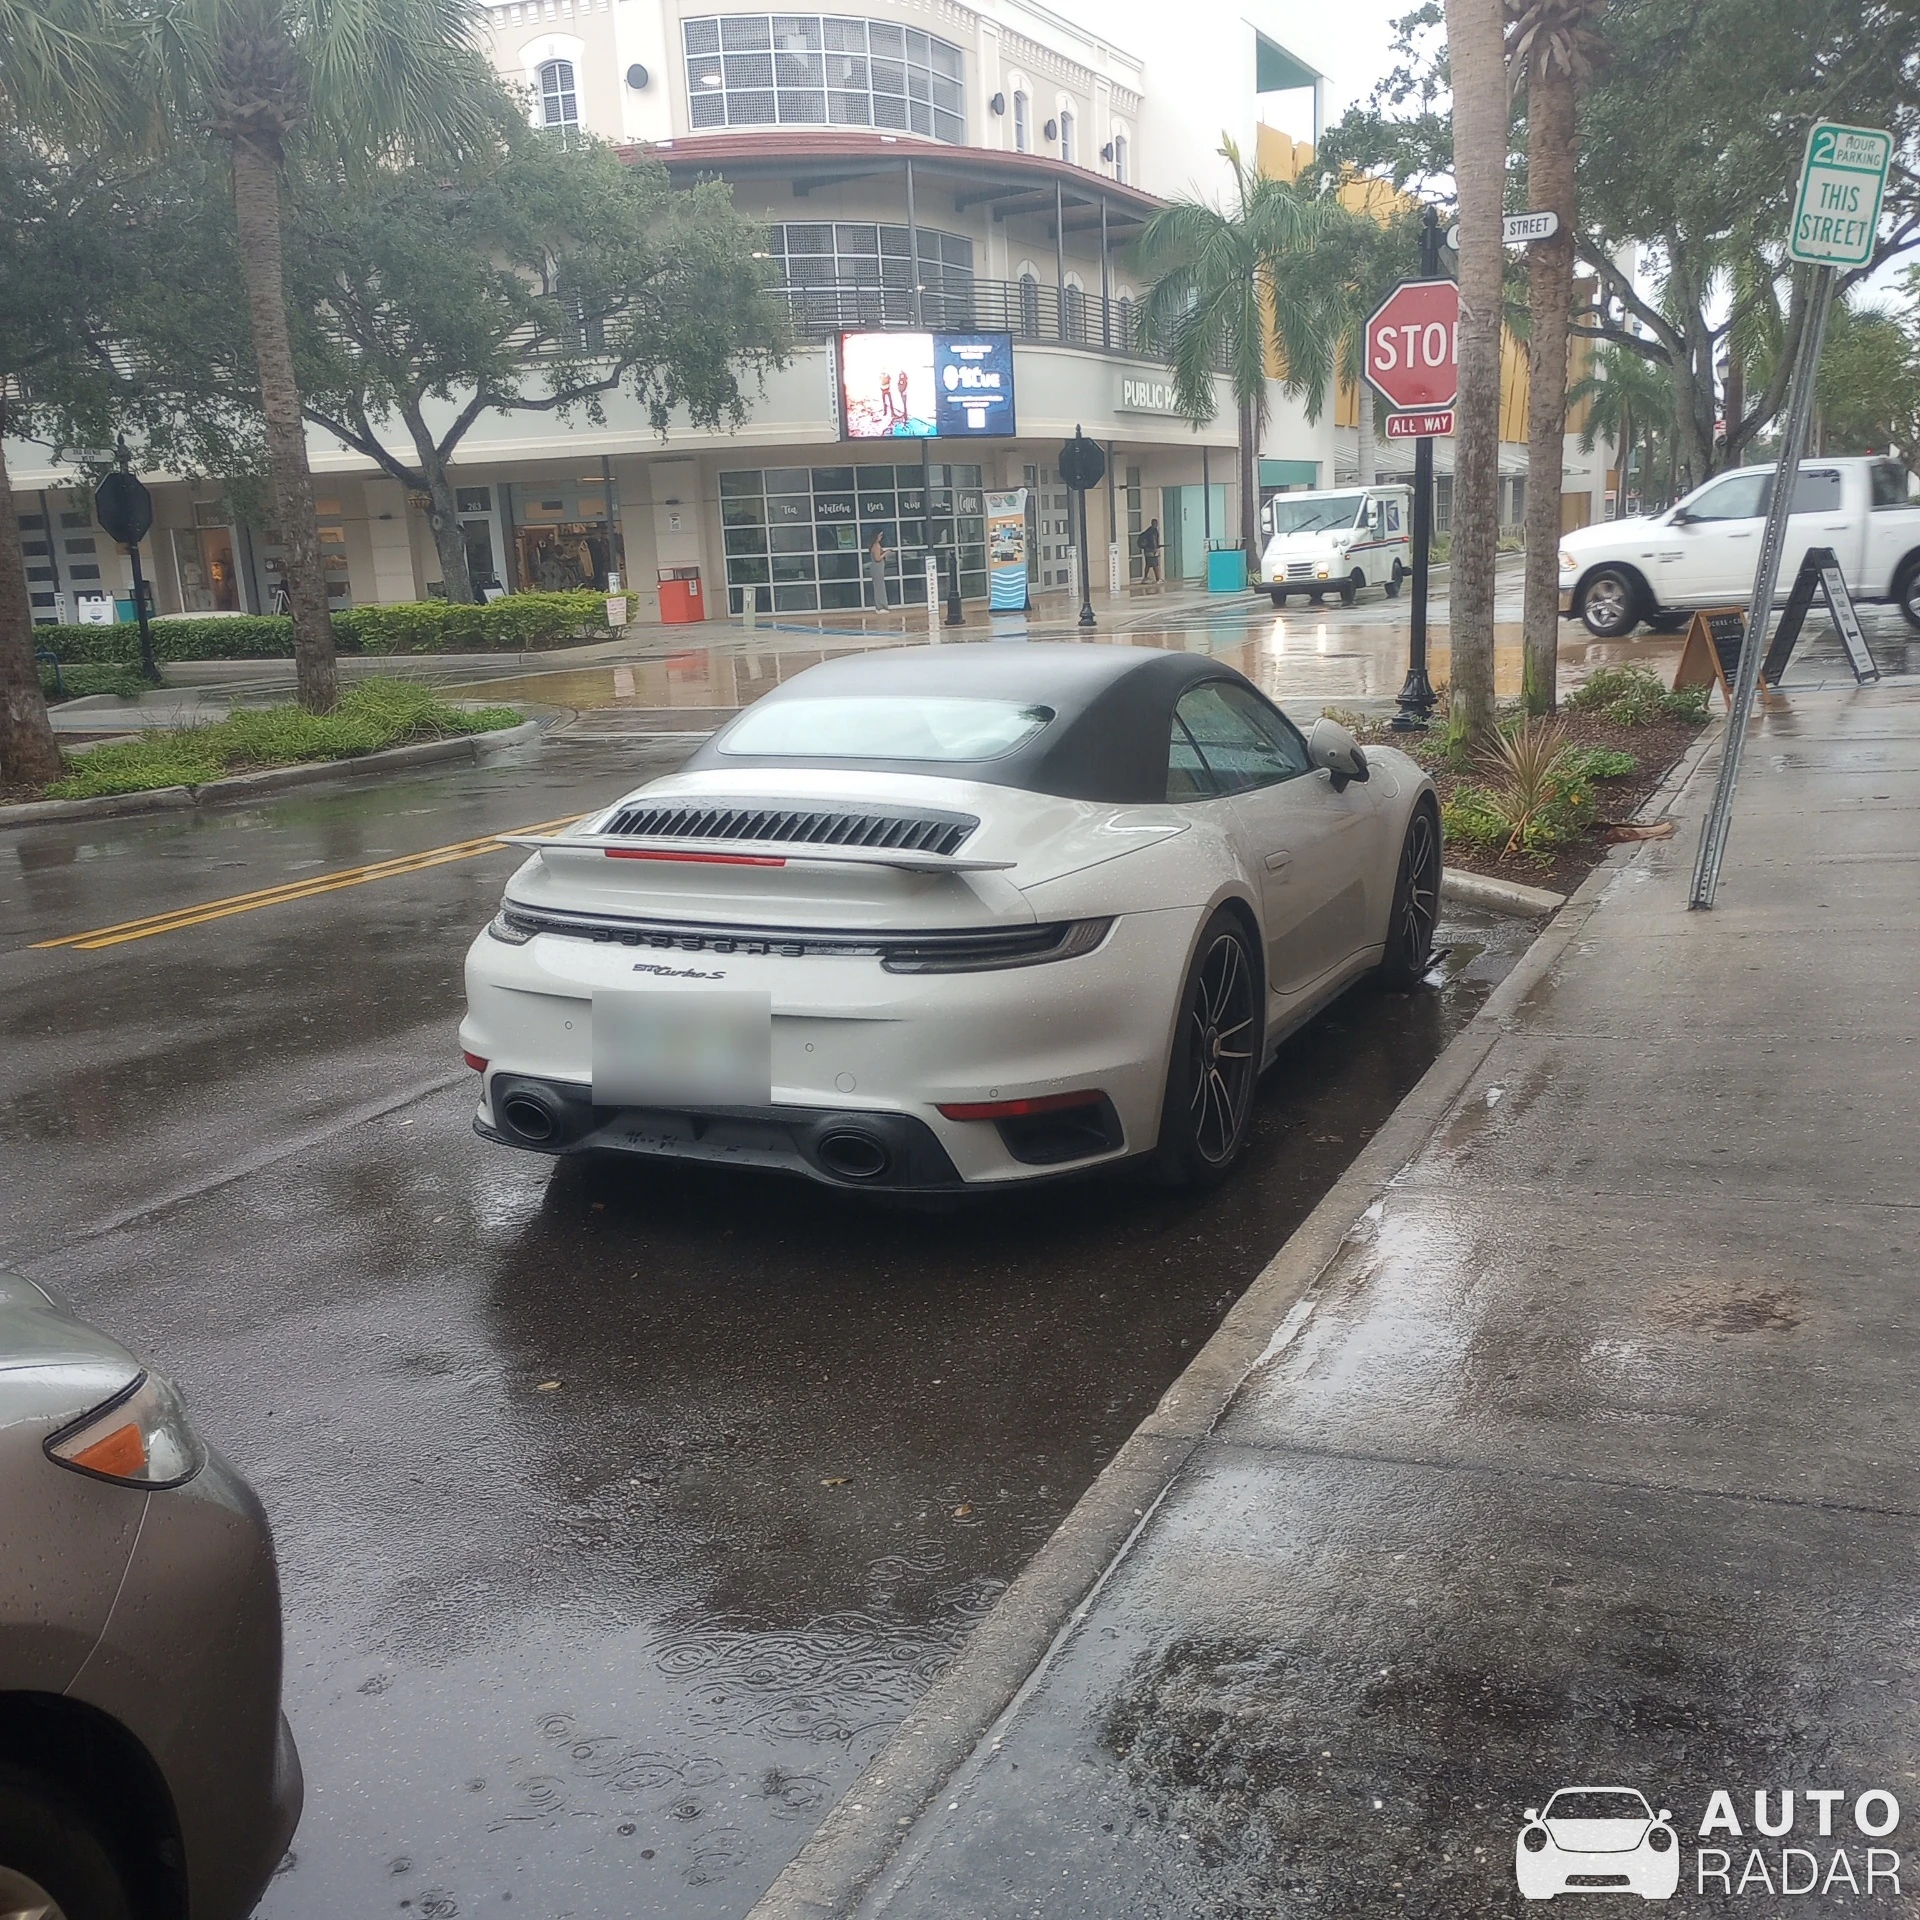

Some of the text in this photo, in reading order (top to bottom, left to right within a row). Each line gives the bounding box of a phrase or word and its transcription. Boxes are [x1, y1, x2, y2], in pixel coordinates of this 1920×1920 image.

[1813, 132, 1836, 164] 2
[1846, 136, 1876, 152] HOUR
[1836, 150, 1881, 167] PARKING
[1820, 182, 1861, 213] THIS
[1509, 217, 1550, 236] STREET
[1800, 214, 1869, 247] STREET
[1123, 379, 1163, 410] PUBLIC
[1391, 415, 1449, 434] ALL WAY
[467, 502, 482, 511] 263
[780, 505, 798, 515] Tea
[867, 501, 885, 512] Beer
[593, 930, 805, 957] PORSCHE
